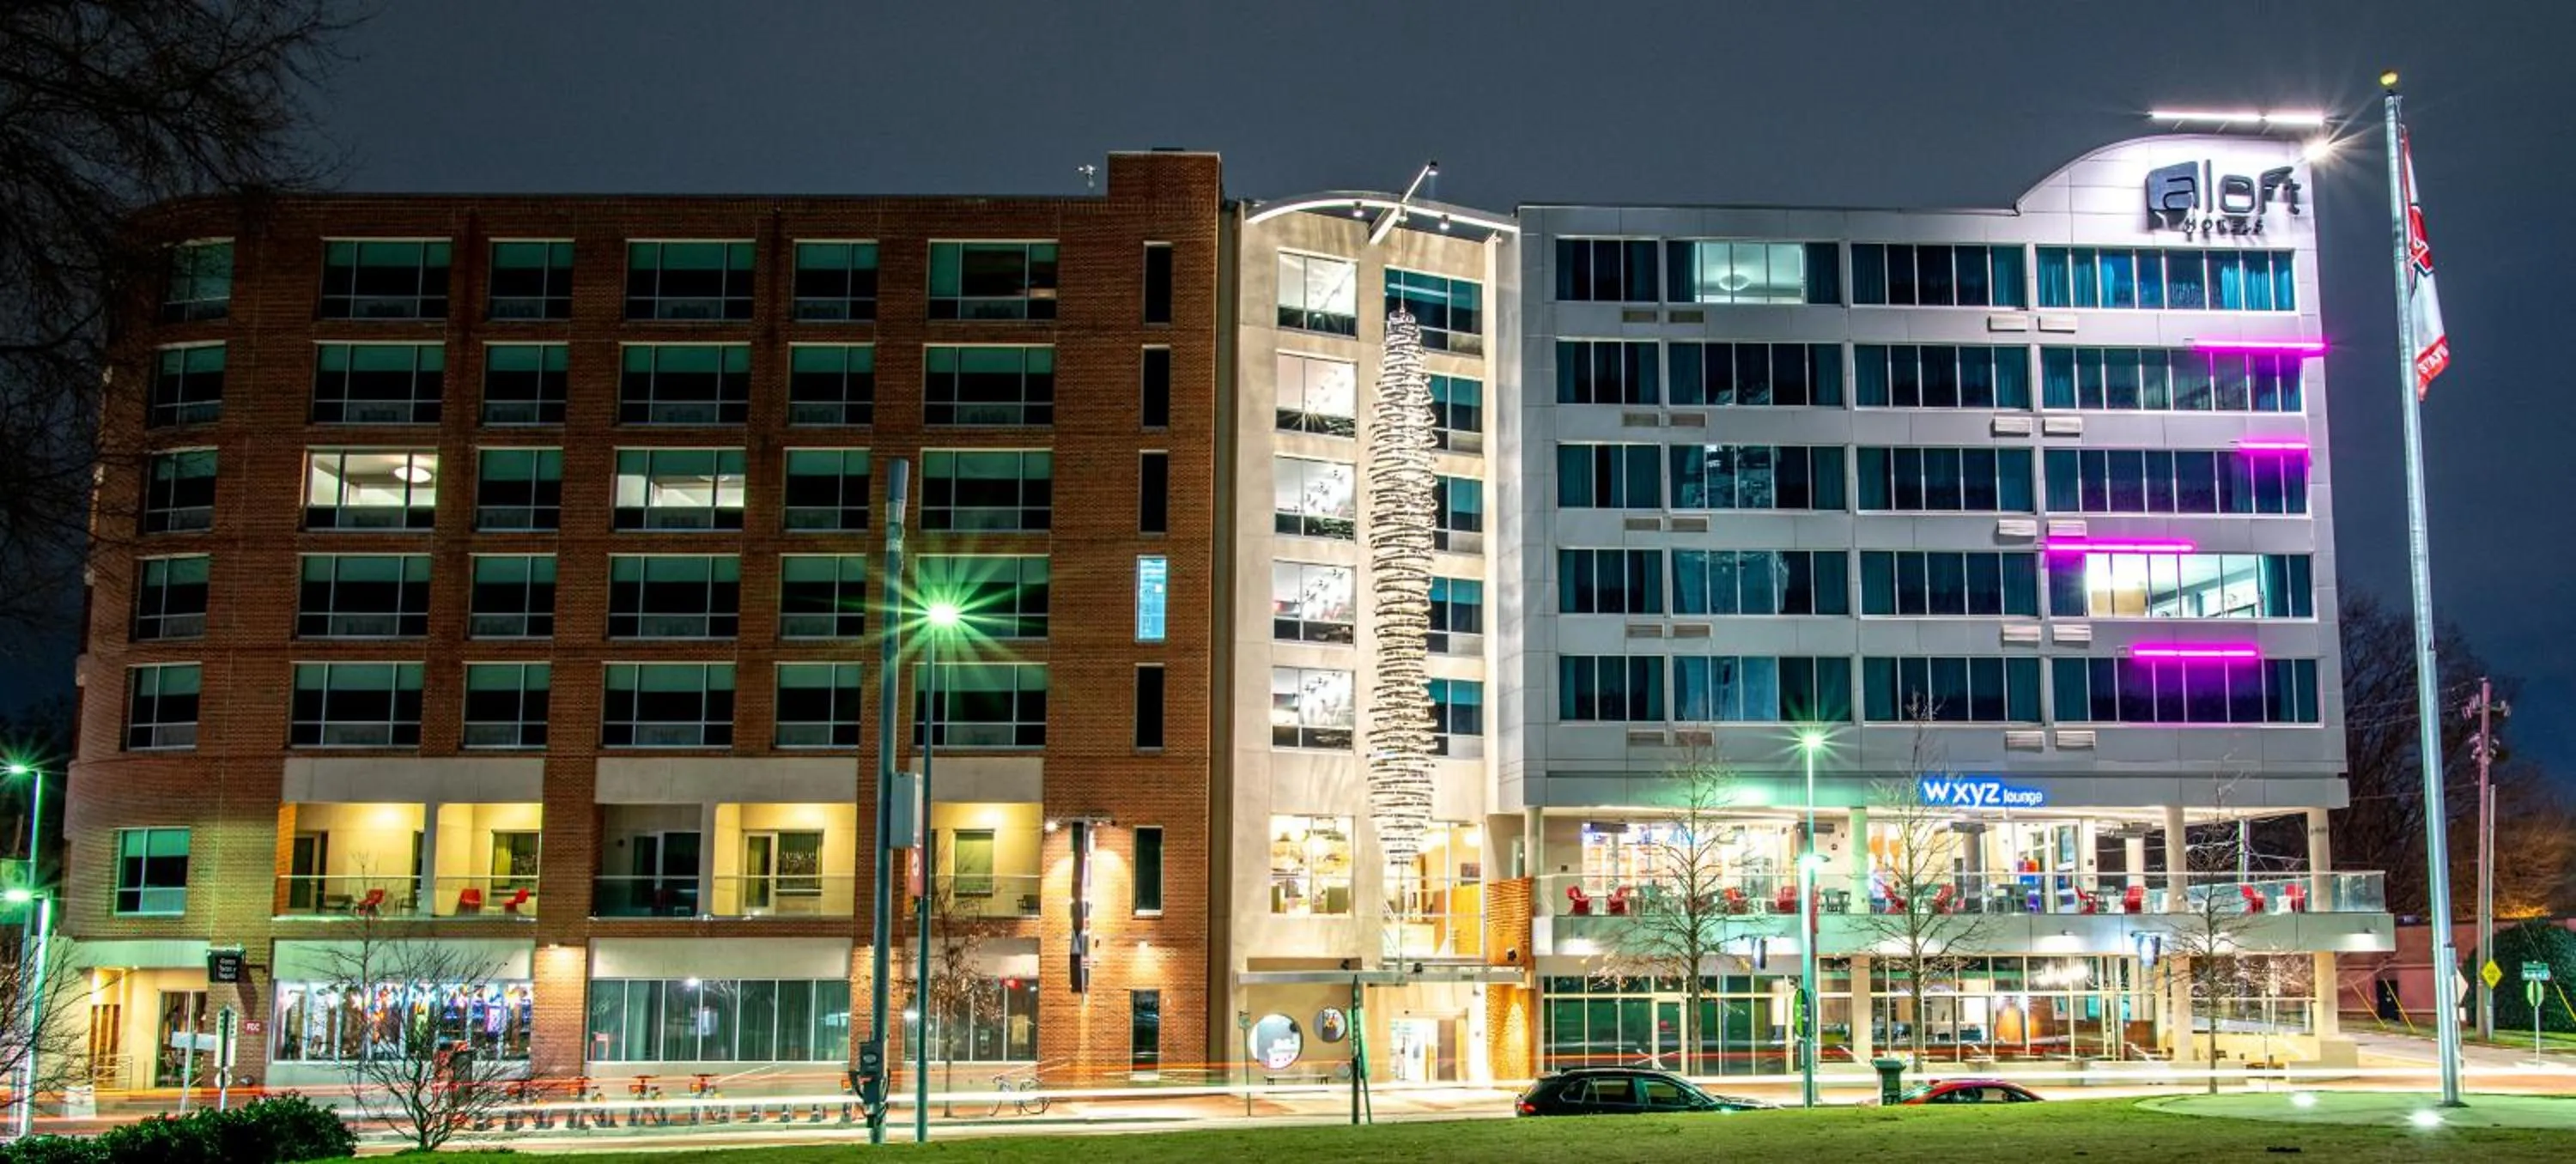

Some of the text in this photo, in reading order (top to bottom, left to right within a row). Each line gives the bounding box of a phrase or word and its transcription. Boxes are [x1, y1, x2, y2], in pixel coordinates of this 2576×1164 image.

[2147, 159, 2301, 215] aloft
[1923, 780, 2043, 809] wxyz lounge
